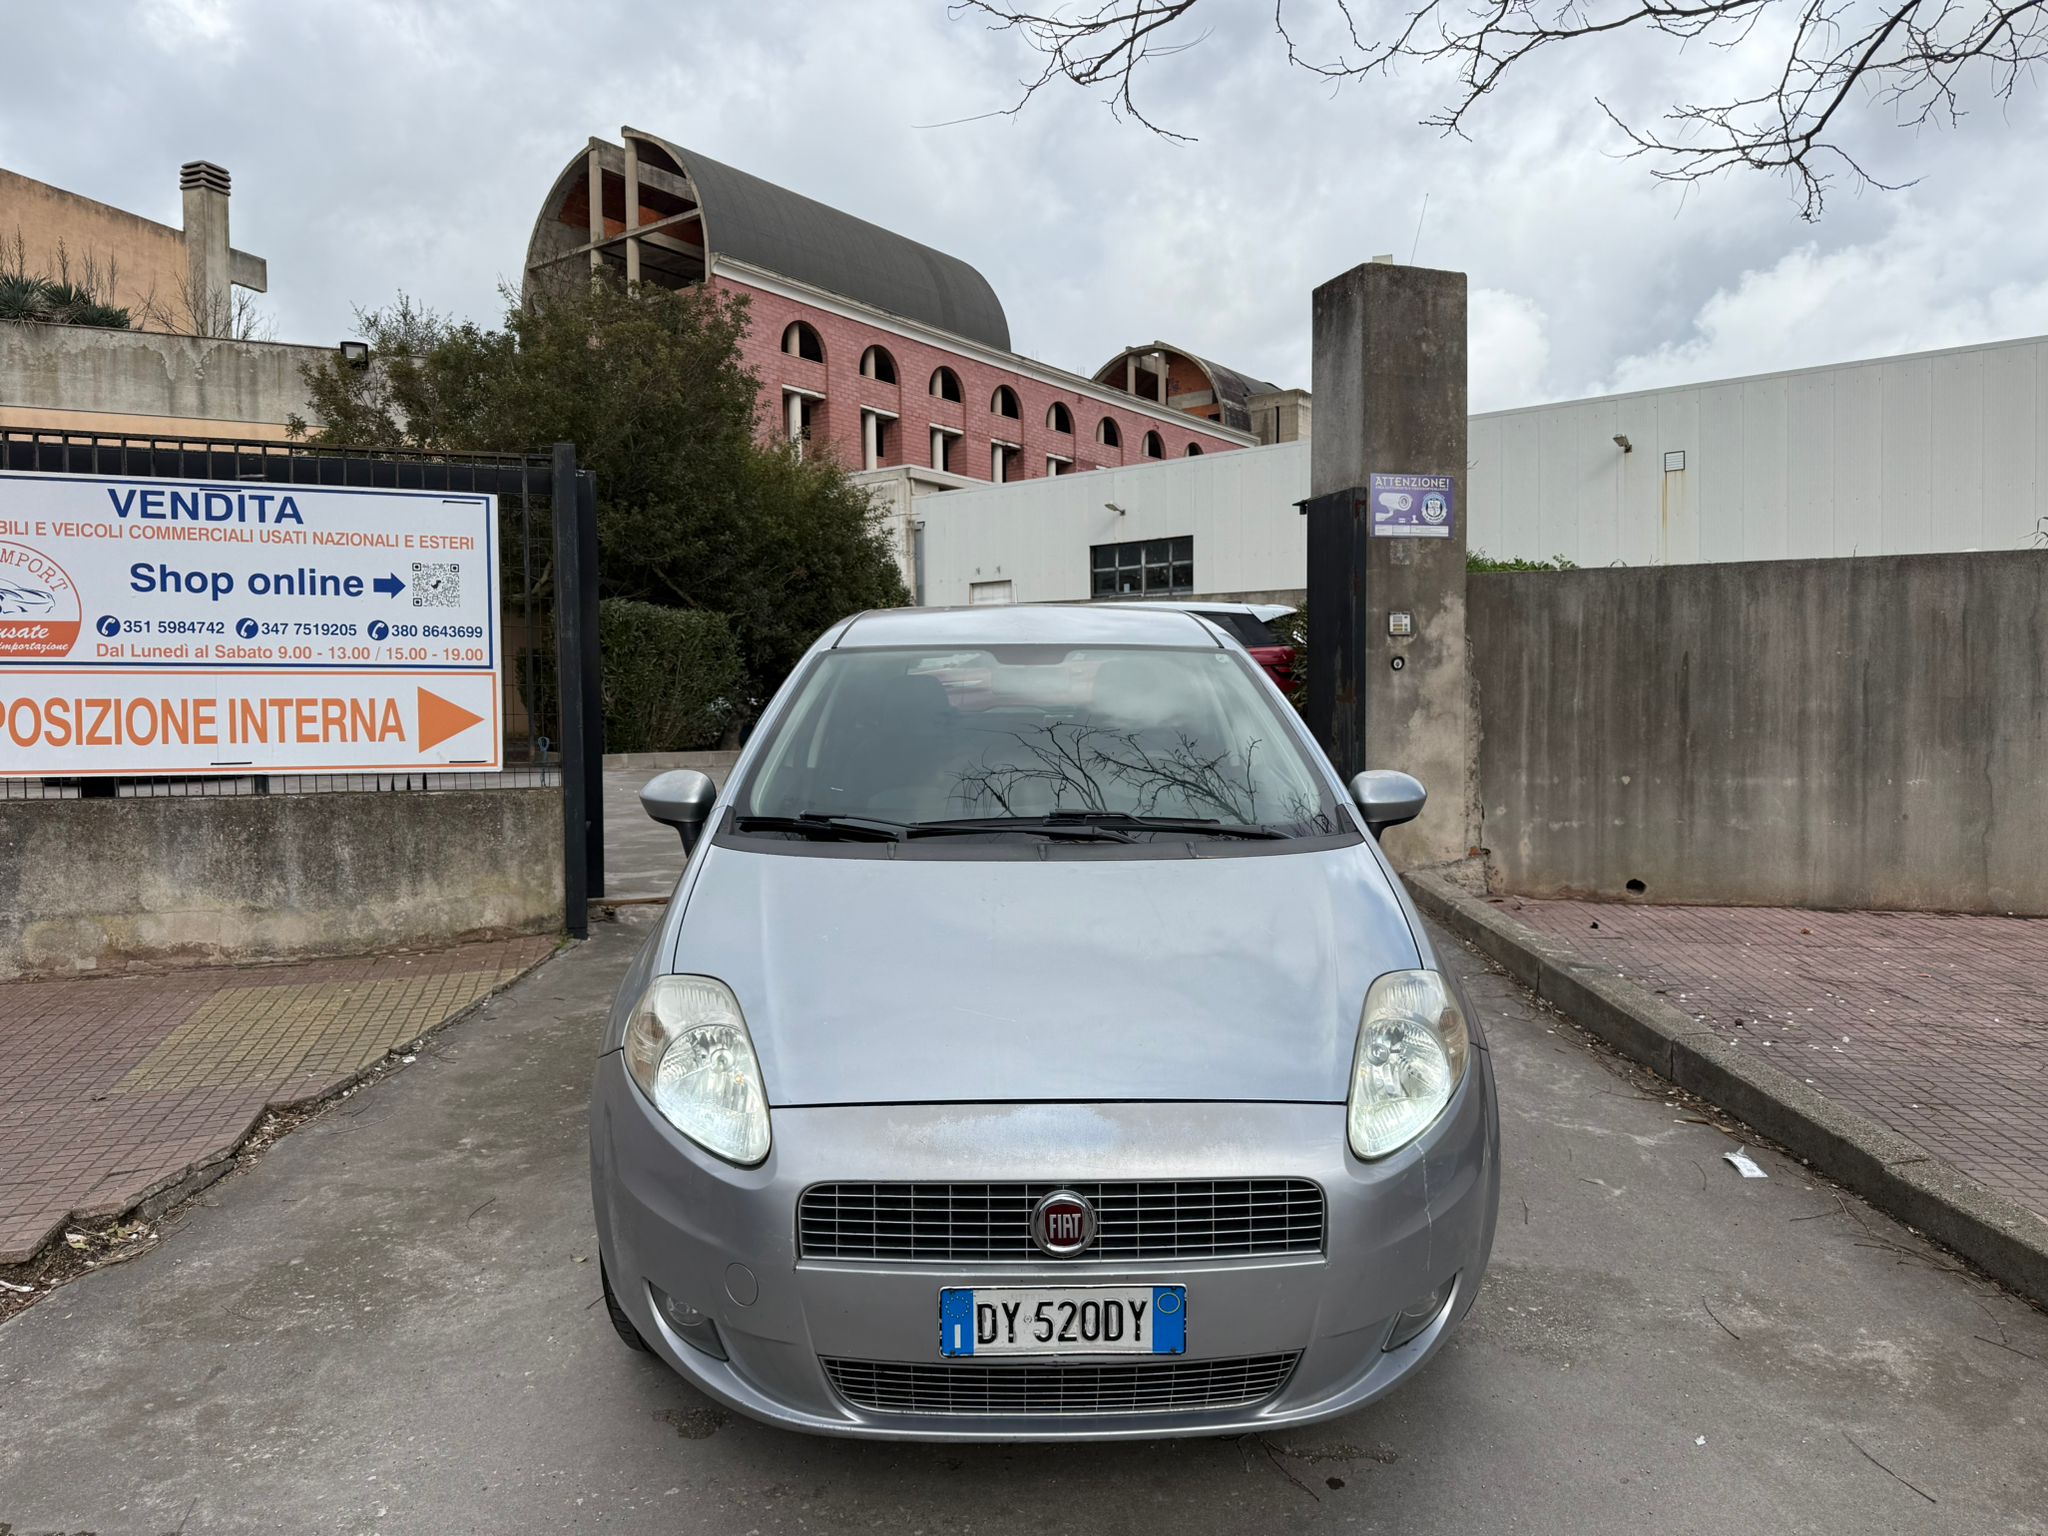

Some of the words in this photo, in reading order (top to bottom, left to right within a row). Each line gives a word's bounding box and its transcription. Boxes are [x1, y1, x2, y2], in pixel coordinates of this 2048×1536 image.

[1375, 476, 1449, 488] ATTENZIONE!
[107, 488, 304, 525] VENDITA
[35, 522, 47, 536] E
[52, 522, 123, 539] VEICOLI
[129, 525, 254, 543] COMMERCIALI
[260, 529, 307, 545] USATI
[313, 531, 399, 548] NAZIONALI
[404, 534, 415, 548] E
[420, 535, 475, 550] ESTERI
[130, 562, 234, 601] Shop
[248, 567, 364, 597] online
[123, 620, 151, 634] 351
[158, 621, 225, 635] 5984742
[261, 622, 289, 636] 347
[294, 623, 357, 637] 7519205
[391, 625, 418, 638] 380
[422, 625, 483, 639] 8643699
[96, 643, 124, 658] Dal
[131, 643, 189, 659] Lunedì
[194, 645, 209, 659] al
[215, 644, 273, 660] Sabato
[278, 646, 313, 660] 9.00
[328, 646, 371, 661] 13.00
[374, 646, 381, 662] /
[386, 647, 427, 661] 15.00
[443, 648, 484, 662] 19.00
[0, 697, 219, 747] OSIZIONE
[228, 698, 406, 744] INTERNA
[1049, 1213, 1082, 1239] FIAT
[977, 1301, 1021, 1344] DY
[1034, 1299, 1148, 1343] 520DY
[954, 1324, 961, 1349] I
